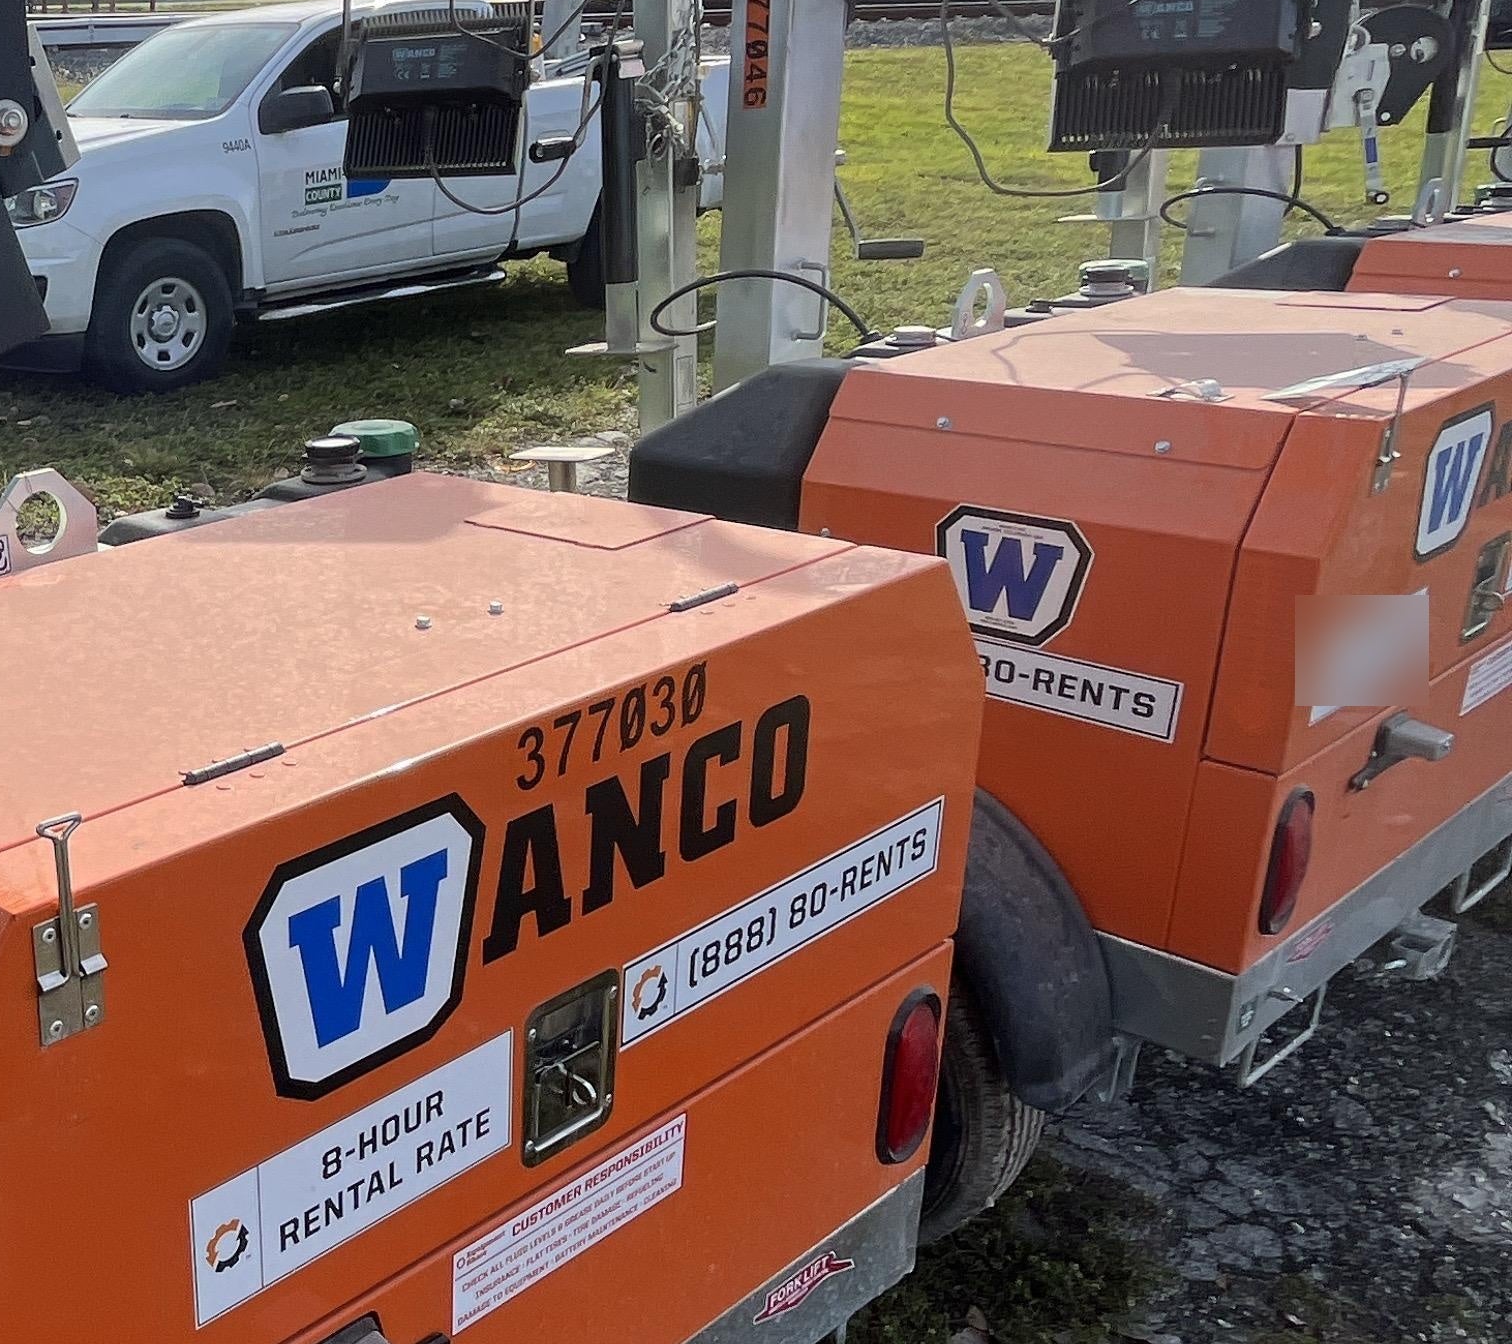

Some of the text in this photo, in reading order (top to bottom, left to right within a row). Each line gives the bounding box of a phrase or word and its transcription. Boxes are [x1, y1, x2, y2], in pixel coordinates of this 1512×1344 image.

[305, 187, 342, 203] COUNTY
[960, 528, 1065, 622] W
[515, 660, 707, 791] 377030
[688, 827, 927, 988] (888) 80-RENTS
[279, 1107, 491, 1253] RENTAL RATE
[321, 1090, 444, 1180] 8-HOUR
[512, 1120, 684, 1237] CUSTOMER RESPONSIBILITY
